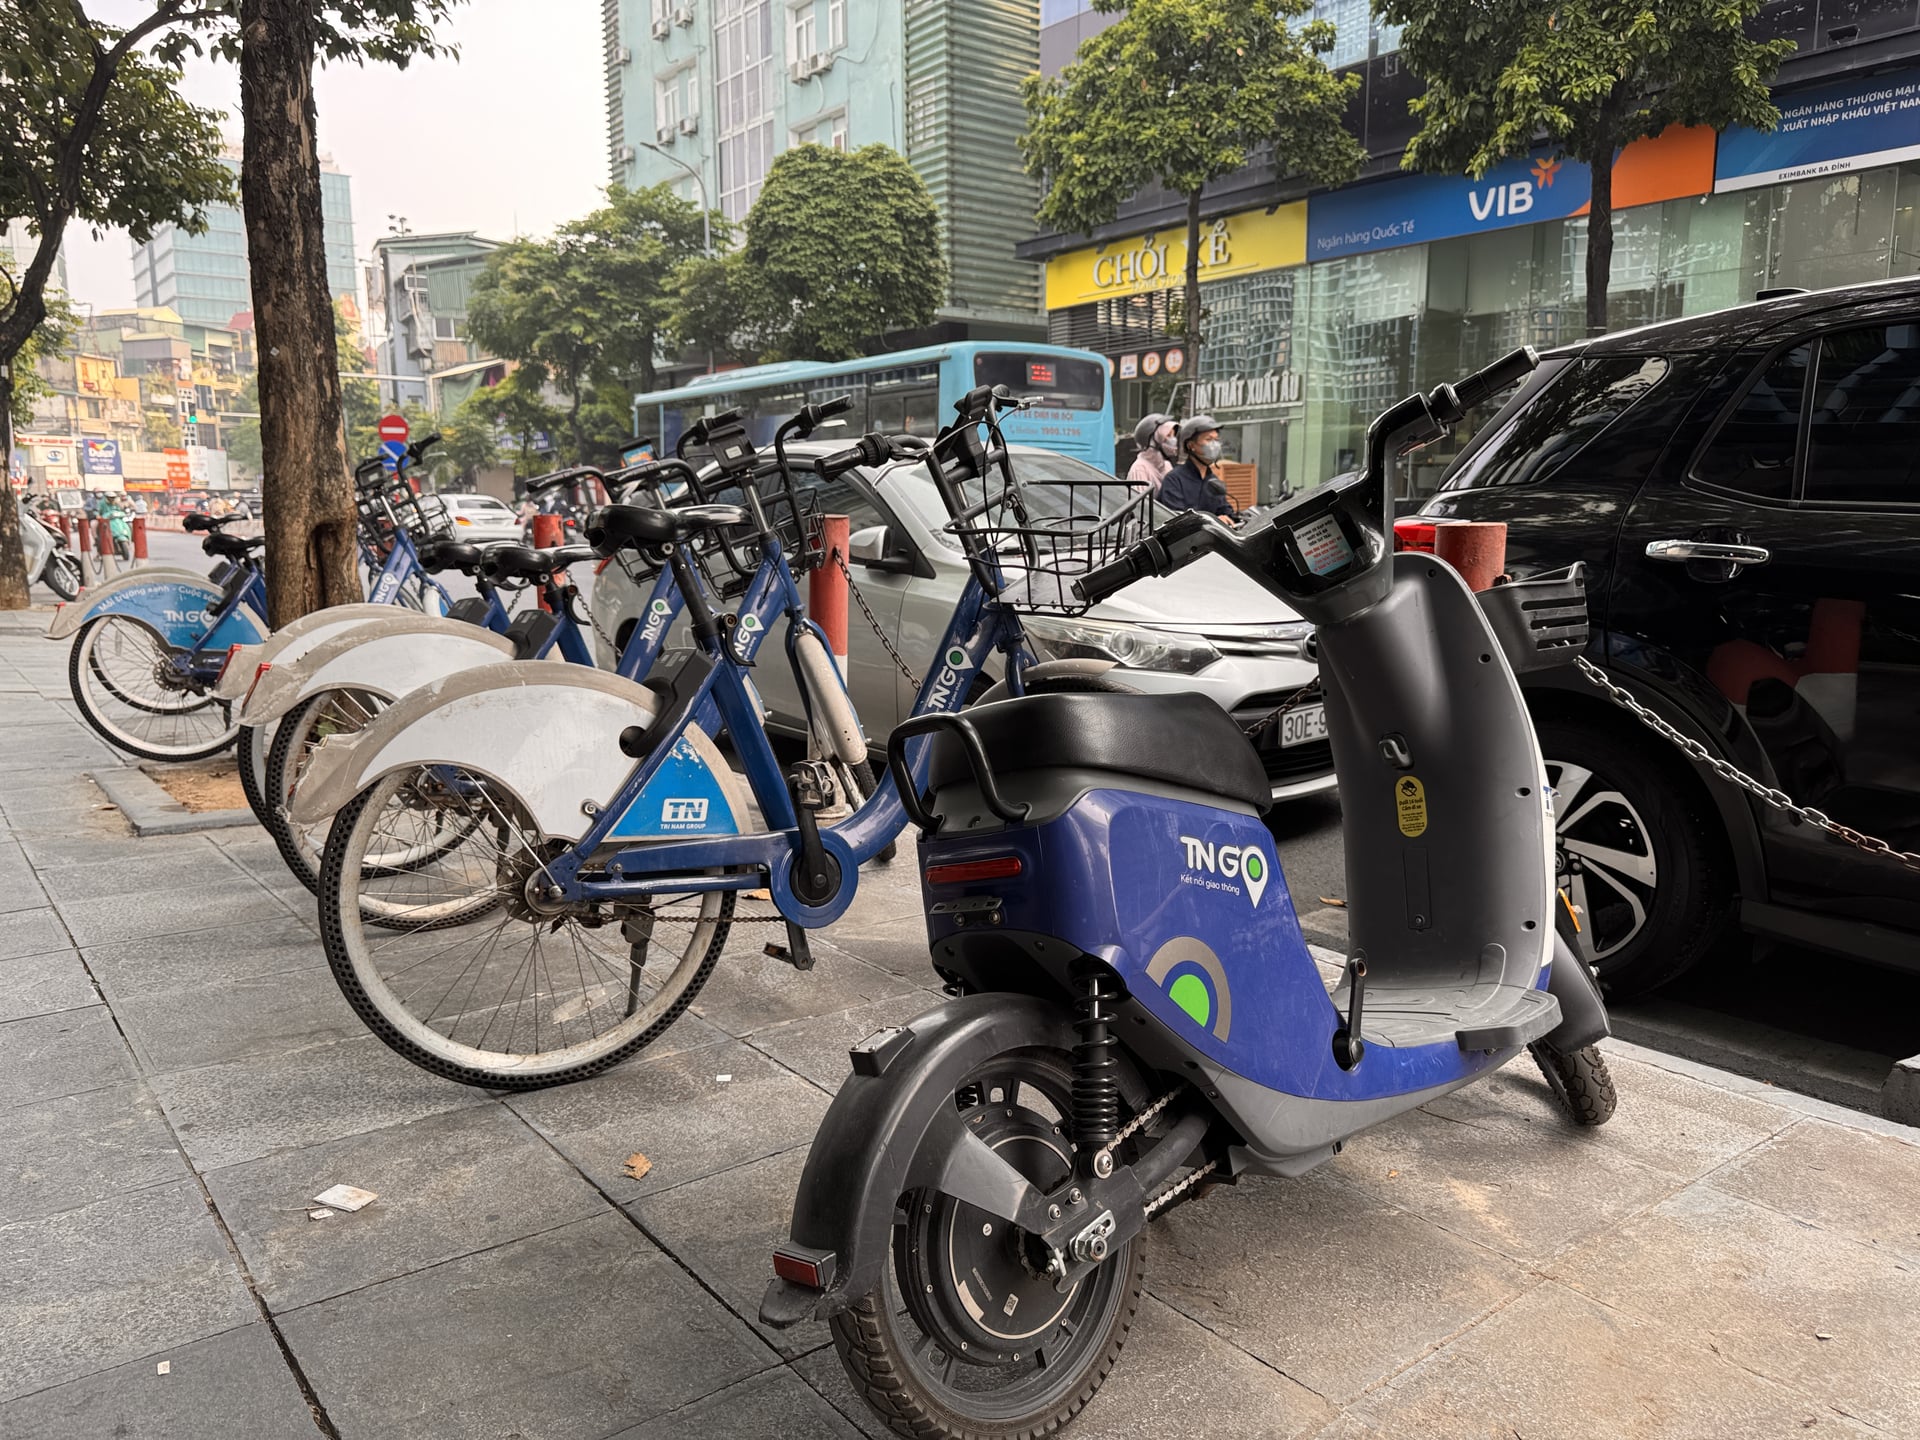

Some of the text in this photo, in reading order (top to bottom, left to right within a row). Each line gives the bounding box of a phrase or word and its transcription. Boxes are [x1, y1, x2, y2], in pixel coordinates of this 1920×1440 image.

[1782, 118, 1808, 133] XUẤT
[1810, 112, 1839, 127] NHẬP
[1873, 99, 1898, 115] VIỆT
[1784, 105, 1812, 119] NGÂN
[1814, 98, 1844, 113] HÀNG
[1846, 88, 1893, 107] THƯƠNG
[1895, 85, 1915, 100] MẠI
[1778, 168, 1817, 180] EXIMBANK
[1818, 165, 1829, 174] BA
[1468, 181, 1534, 222] VIB
[1317, 218, 1415, 251] Ngân hàng Quốc Tế
[1180, 873, 1240, 896] Kết nối giao thông
